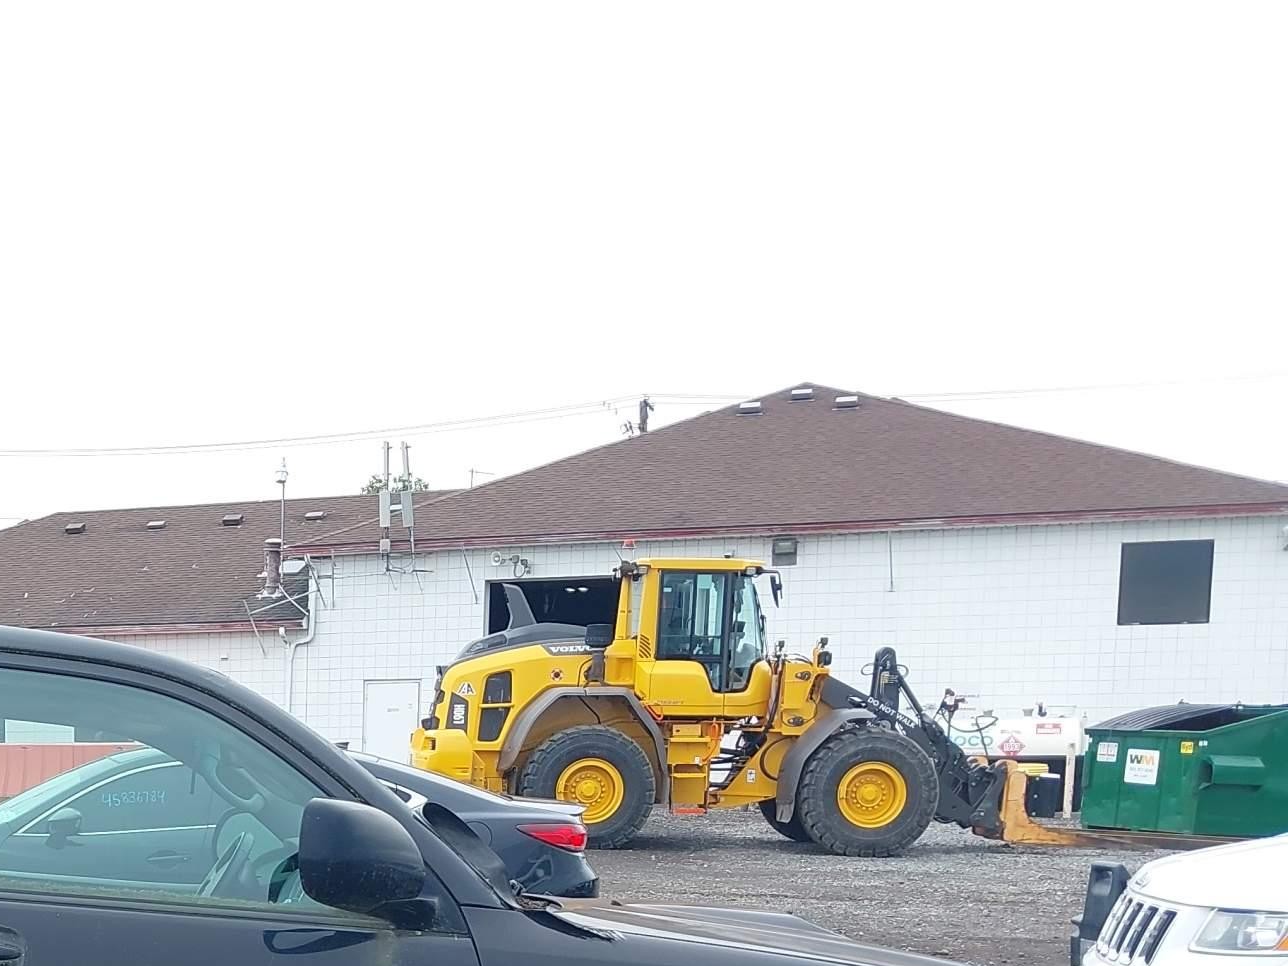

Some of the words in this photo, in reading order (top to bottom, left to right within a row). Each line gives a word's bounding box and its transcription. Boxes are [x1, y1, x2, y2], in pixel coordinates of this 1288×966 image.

[867, 696, 880, 707] DO
[879, 703, 897, 716] NOT
[896, 712, 918, 729] WALK
[1129, 754, 1155, 766] WM
